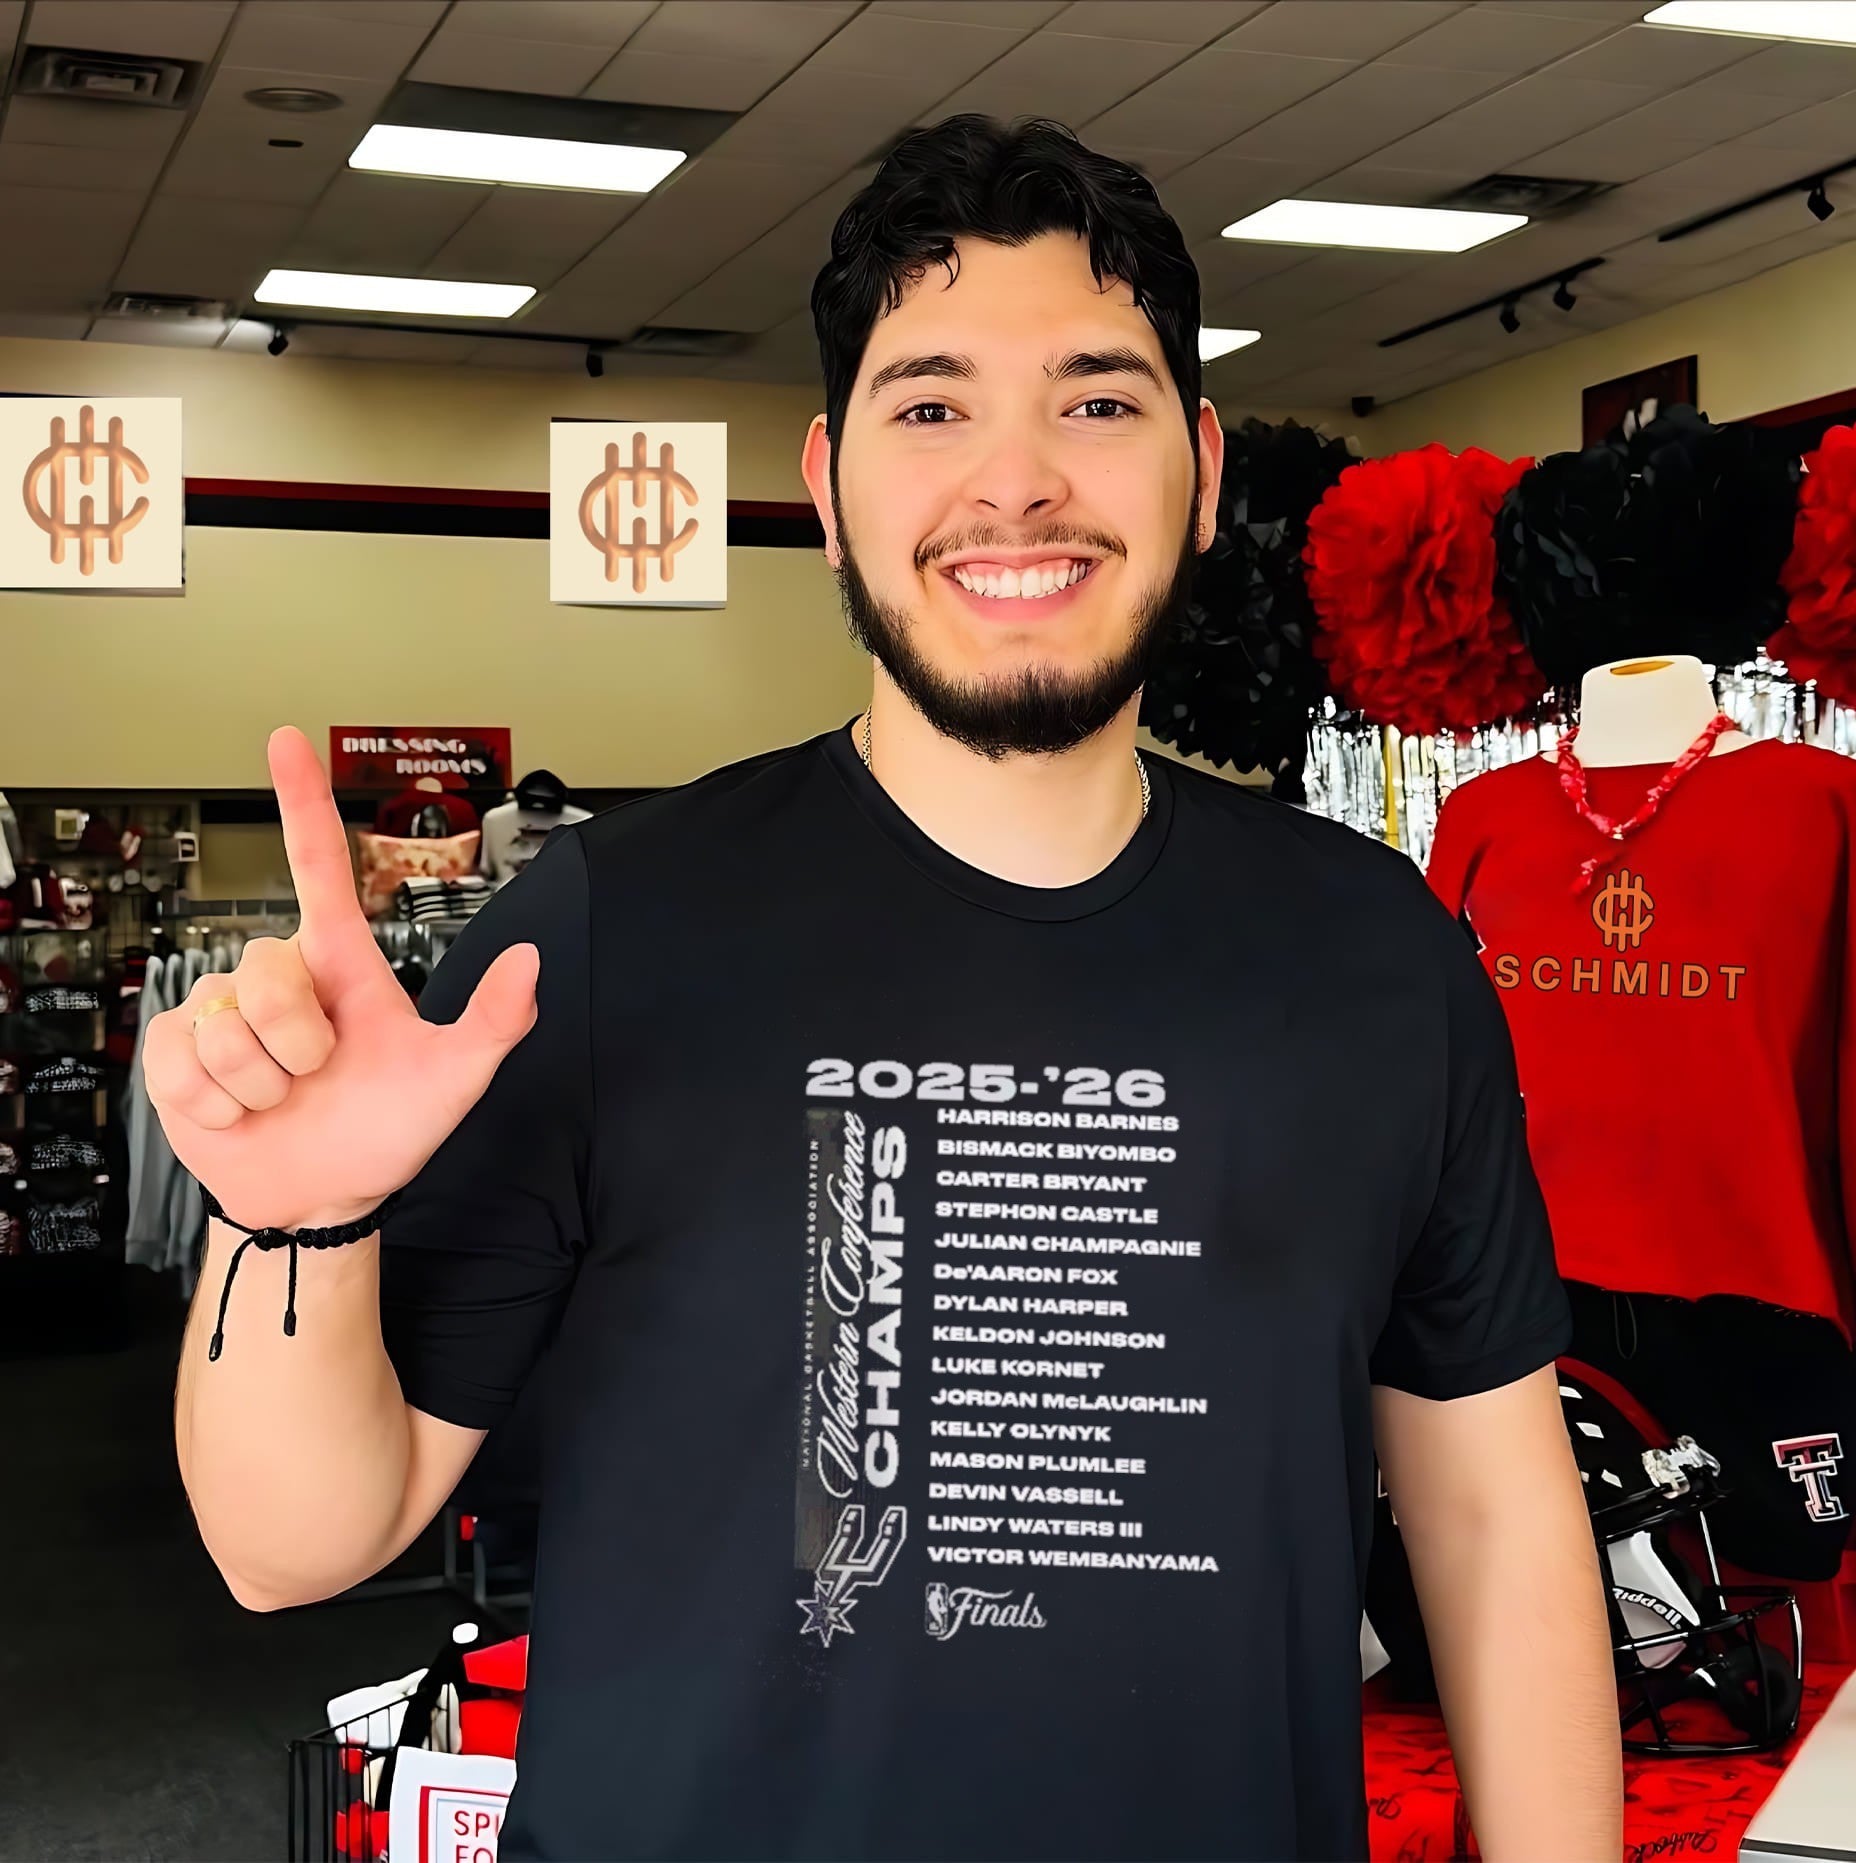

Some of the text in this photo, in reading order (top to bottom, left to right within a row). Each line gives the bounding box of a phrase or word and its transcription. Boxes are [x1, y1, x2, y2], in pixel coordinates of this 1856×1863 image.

[341, 737, 467, 754] DRESSING
[396, 758, 487, 775] ROOMS
[1494, 954, 1747, 1000] SCHMIDT
[805, 1058, 1166, 1108] 2025-'26
[936, 1107, 1180, 1132] HARRISON BARNES
[937, 1138, 1177, 1163] BISMACK BIYOMBO
[936, 1170, 1148, 1193] CARTER BRYANT
[934, 1200, 1159, 1225] STEPHON CASTLE
[934, 1232, 1202, 1257] JULIAN CHAMPAGNIE
[933, 1263, 1119, 1286] De'AARON FOX
[817, 1110, 875, 1499] Western Conference
[865, 1125, 907, 1488] CHAMPS
[933, 1294, 1129, 1317] DYLAN HARPER
[932, 1325, 1166, 1350] KELDON JOHNSON
[931, 1356, 1105, 1379] LUKE KORNET
[930, 1388, 1208, 1415] JORDAN McLAUGHLIN
[930, 1419, 1112, 1442] KELLY OLYNYK
[929, 1451, 1147, 1475] MASON PLUMLEE
[928, 1482, 1124, 1506] DEVIN VASSELL
[927, 1514, 1143, 1538] LINDY WATERS III
[926, 1546, 1220, 1573] VICTOR WEMBANYAMA
[937, 1587, 1047, 1640] Finals
